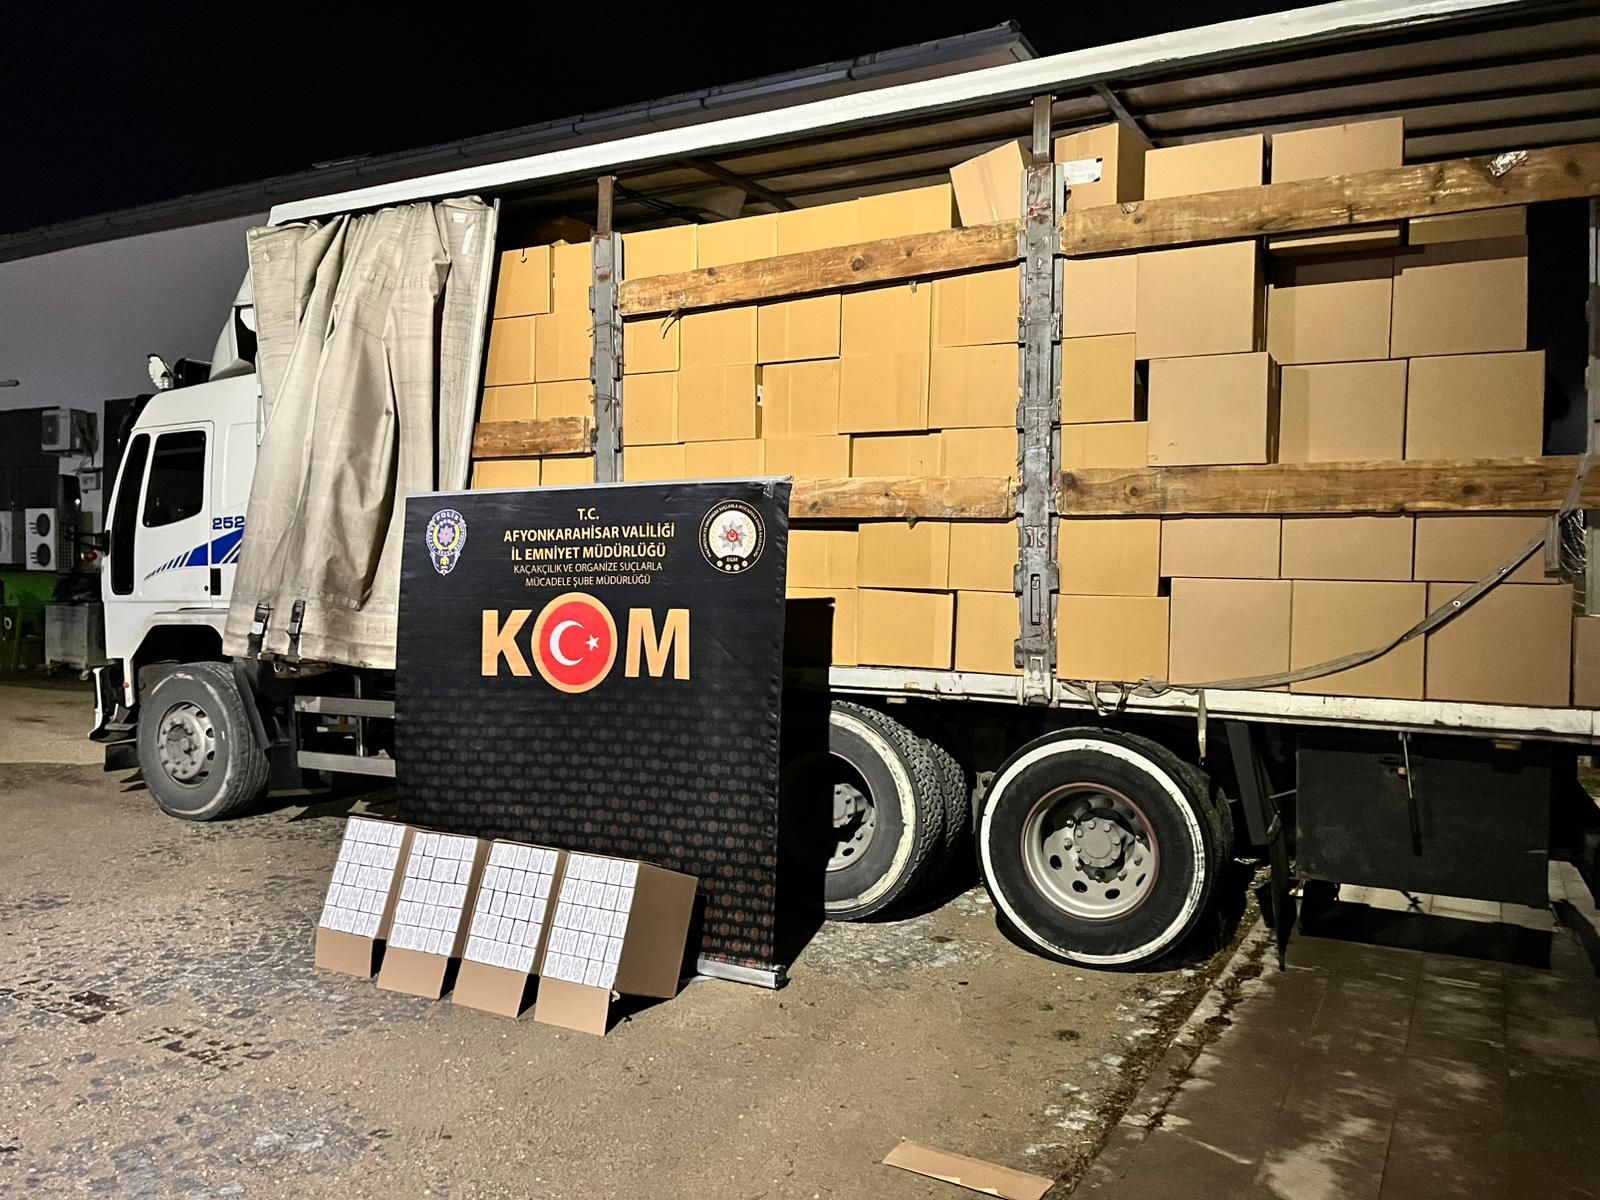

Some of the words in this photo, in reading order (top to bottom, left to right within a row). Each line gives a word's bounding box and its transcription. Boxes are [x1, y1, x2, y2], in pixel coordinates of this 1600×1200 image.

[577, 508, 600, 520] T.C.
[503, 524, 620, 542] AFYONKARAHİSAR
[622, 522, 675, 538] VALİLİĞİ
[511, 546, 522, 561] İL
[525, 545, 580, 561] EMNİYET
[582, 542, 667, 559] MÜDÜRLÜĞÜ
[513, 564, 562, 575] KAÇAKÇILIK
[563, 563, 574, 573] VE
[575, 561, 618, 573] ORGANİZE
[619, 561, 663, 573] SUÇLARLA
[525, 576, 572, 587] MÜCADELE
[573, 576, 594, 588] ŞUBE
[595, 574, 651, 586] MÜDÜRLÜĞÜ
[481, 592, 691, 694] KOM
